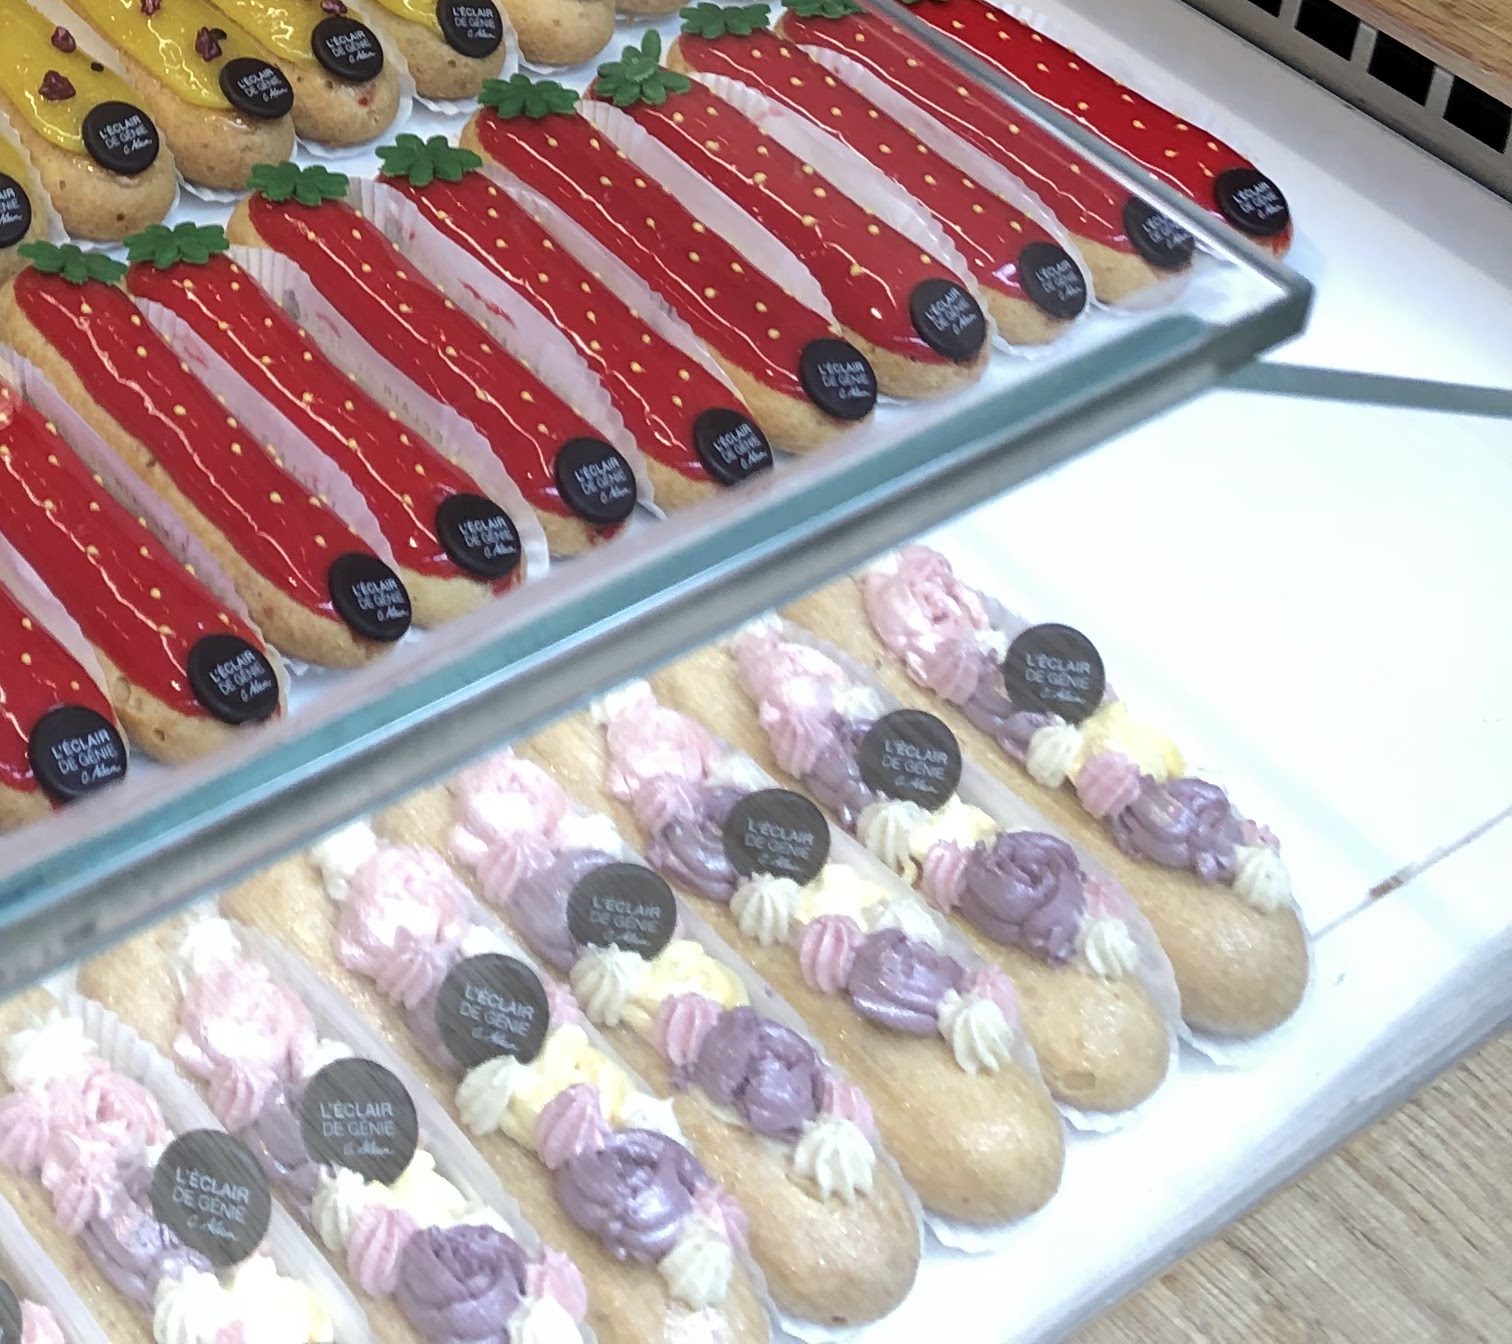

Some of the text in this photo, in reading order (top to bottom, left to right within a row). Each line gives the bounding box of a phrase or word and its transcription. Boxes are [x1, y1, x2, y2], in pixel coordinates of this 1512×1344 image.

[454, 18, 467, 27] DE
[330, 47, 344, 57] DE
[103, 135, 118, 147] DE
